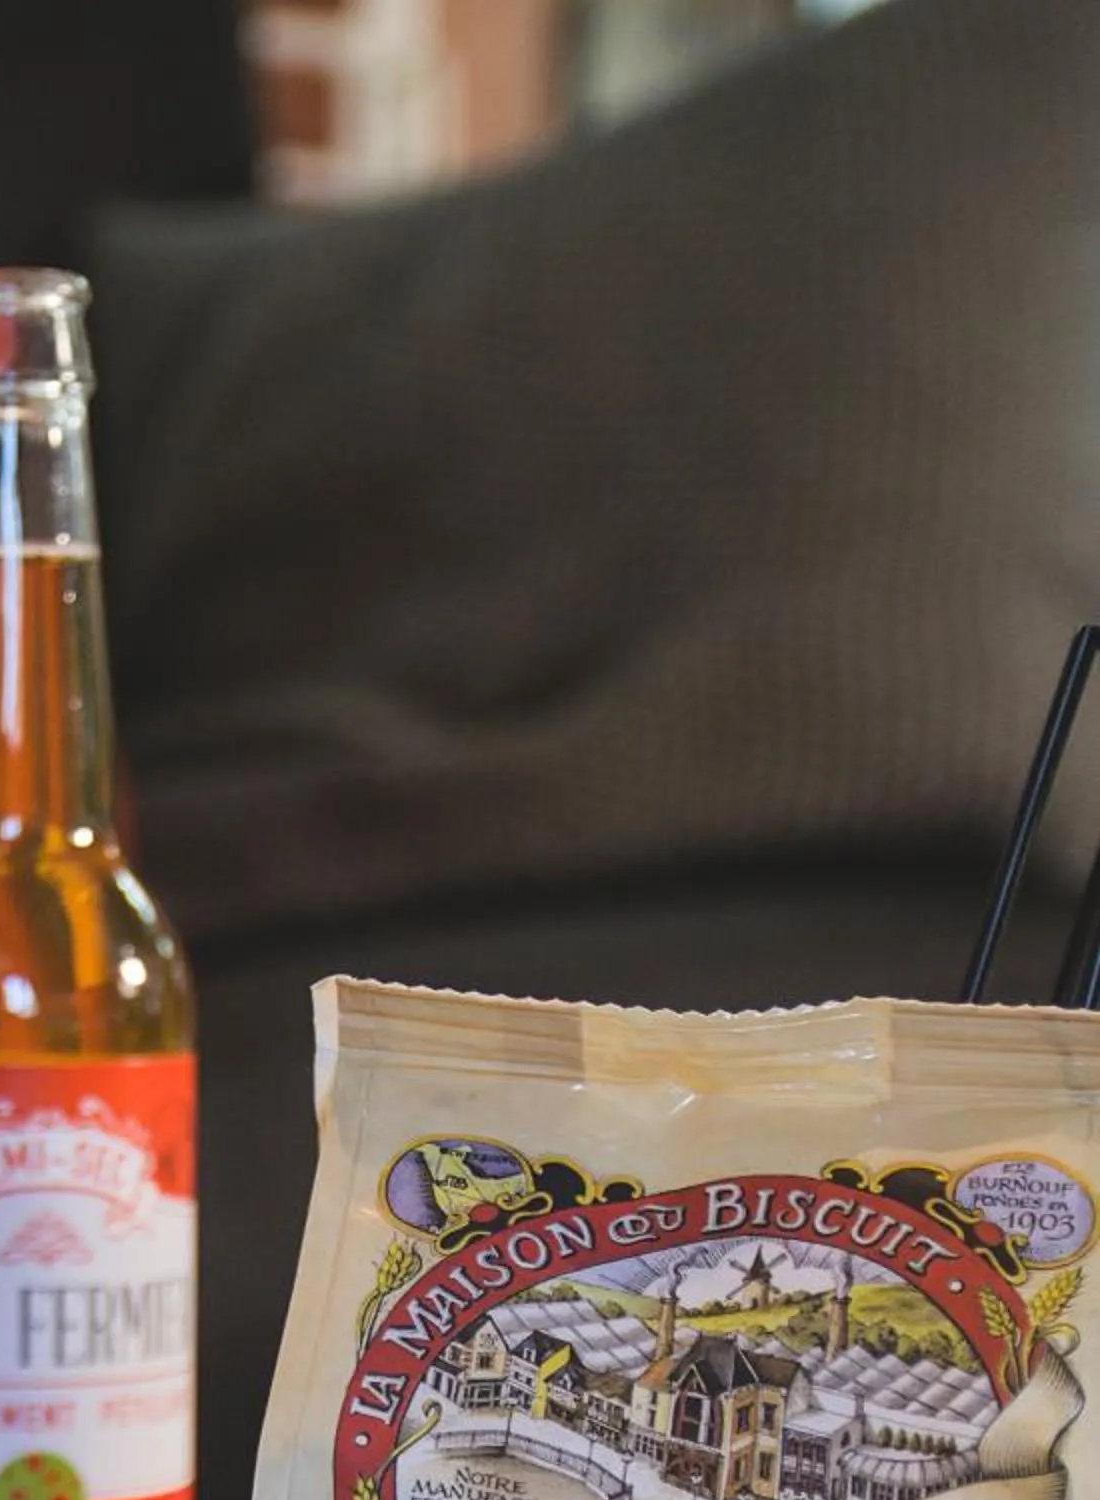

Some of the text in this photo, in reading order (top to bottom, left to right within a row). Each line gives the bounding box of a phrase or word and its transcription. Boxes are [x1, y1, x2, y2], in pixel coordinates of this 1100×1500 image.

[967, 1175, 1074, 1197] BURNOUF
[1007, 1211, 1076, 1241] 1903
[351, 1372, 409, 1427] LA
[383, 1215, 595, 1360] MAISON
[701, 1182, 962, 1278] BISCUIT
[456, 1466, 527, 1495] NOTRE
